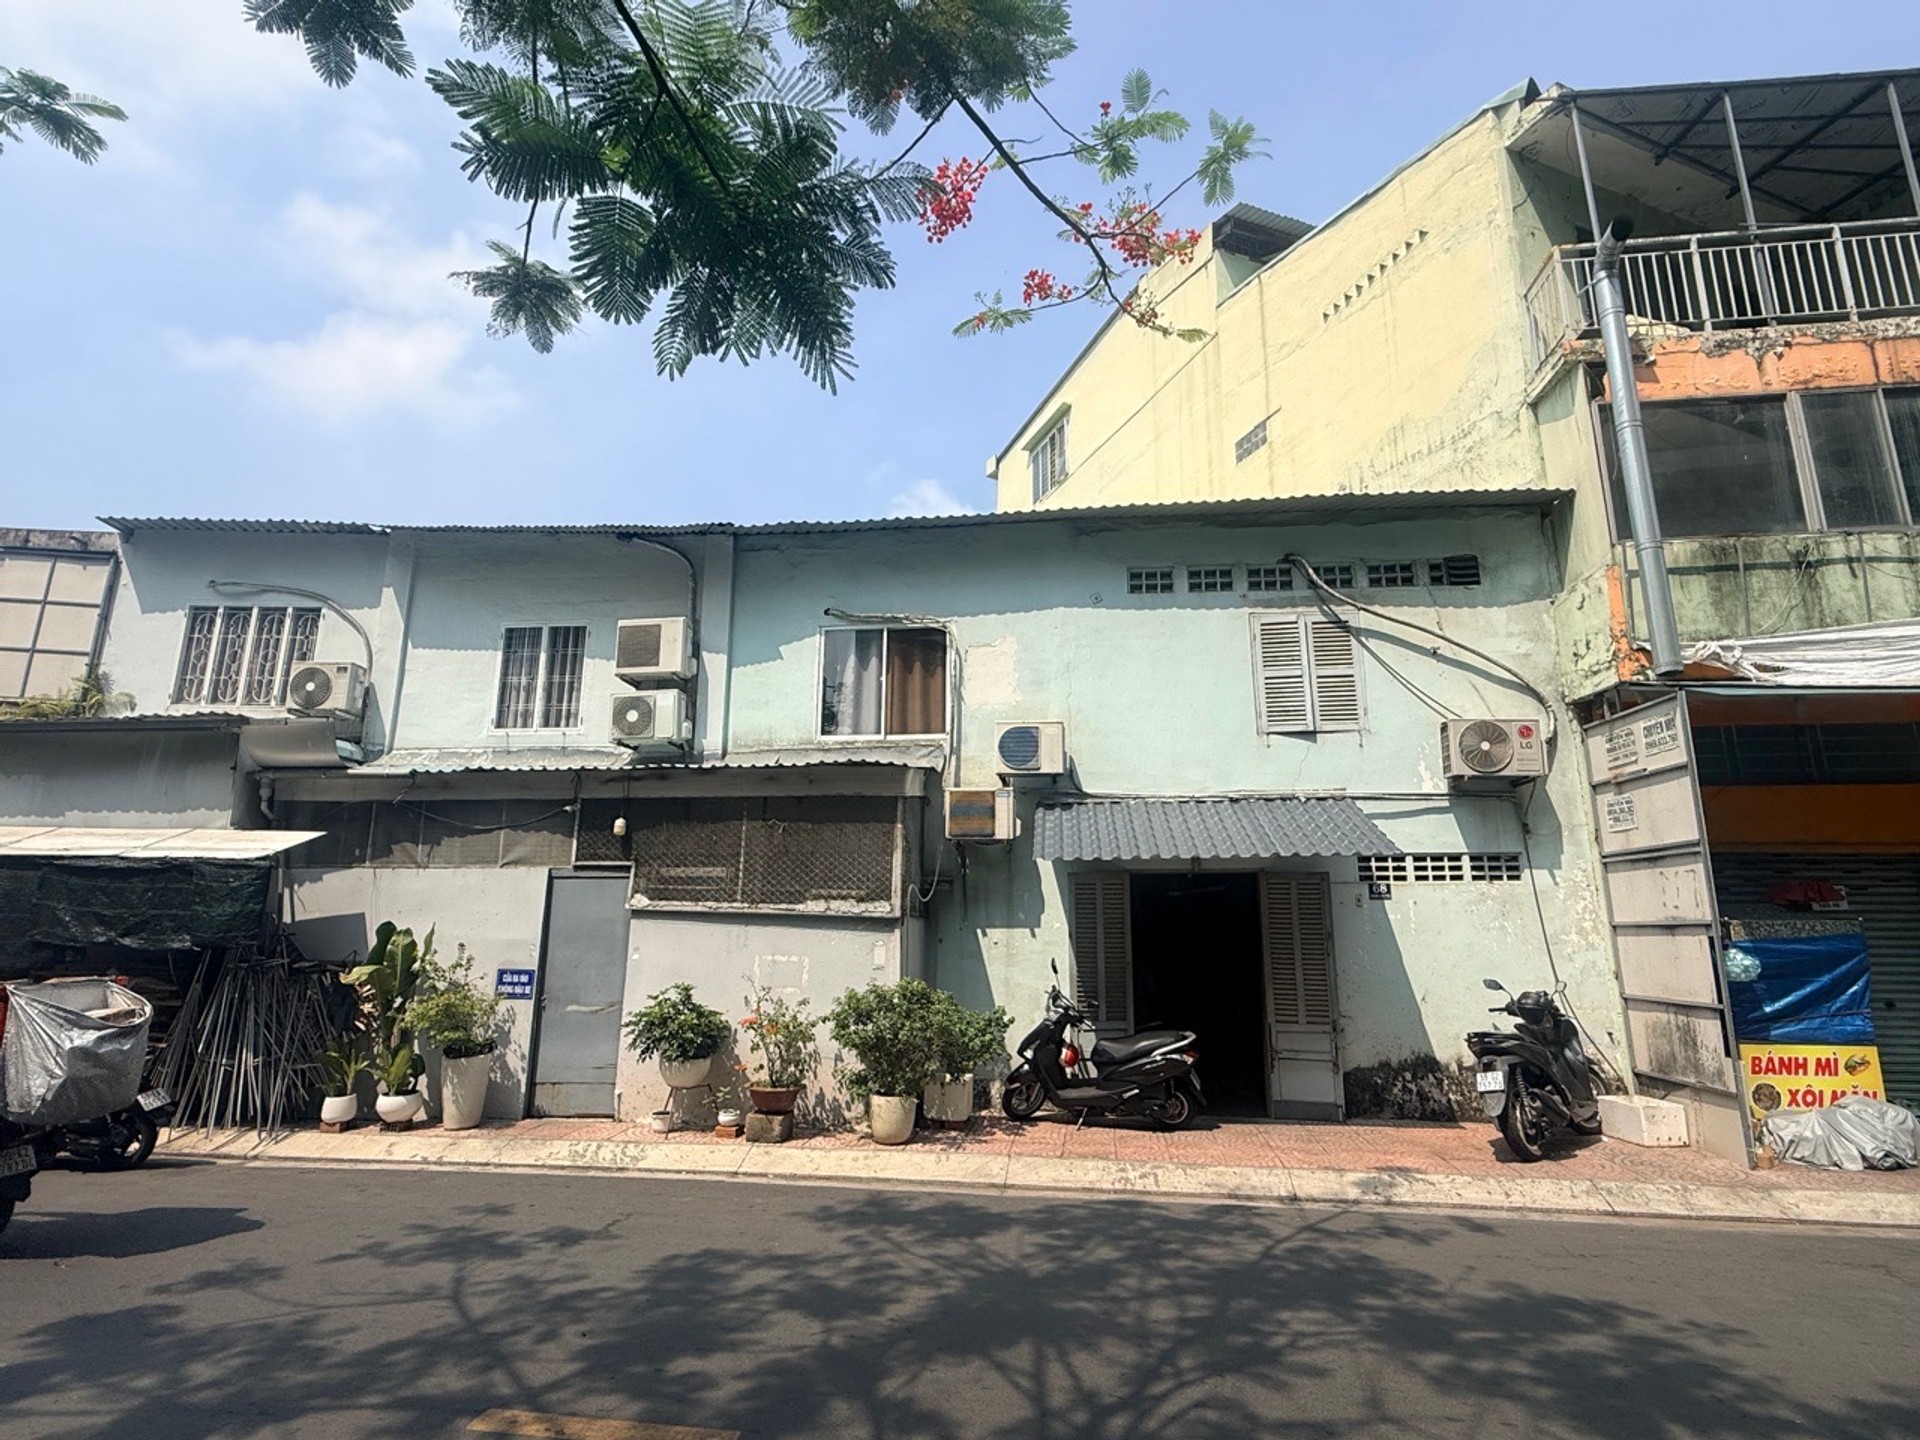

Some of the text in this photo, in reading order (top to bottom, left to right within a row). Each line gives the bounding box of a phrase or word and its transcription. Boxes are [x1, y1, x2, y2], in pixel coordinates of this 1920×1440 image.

[1520, 741, 1533, 750] LG
[1750, 1050, 1839, 1077] BÁNH MÌ
[1786, 1084, 1824, 1108] XÔI
